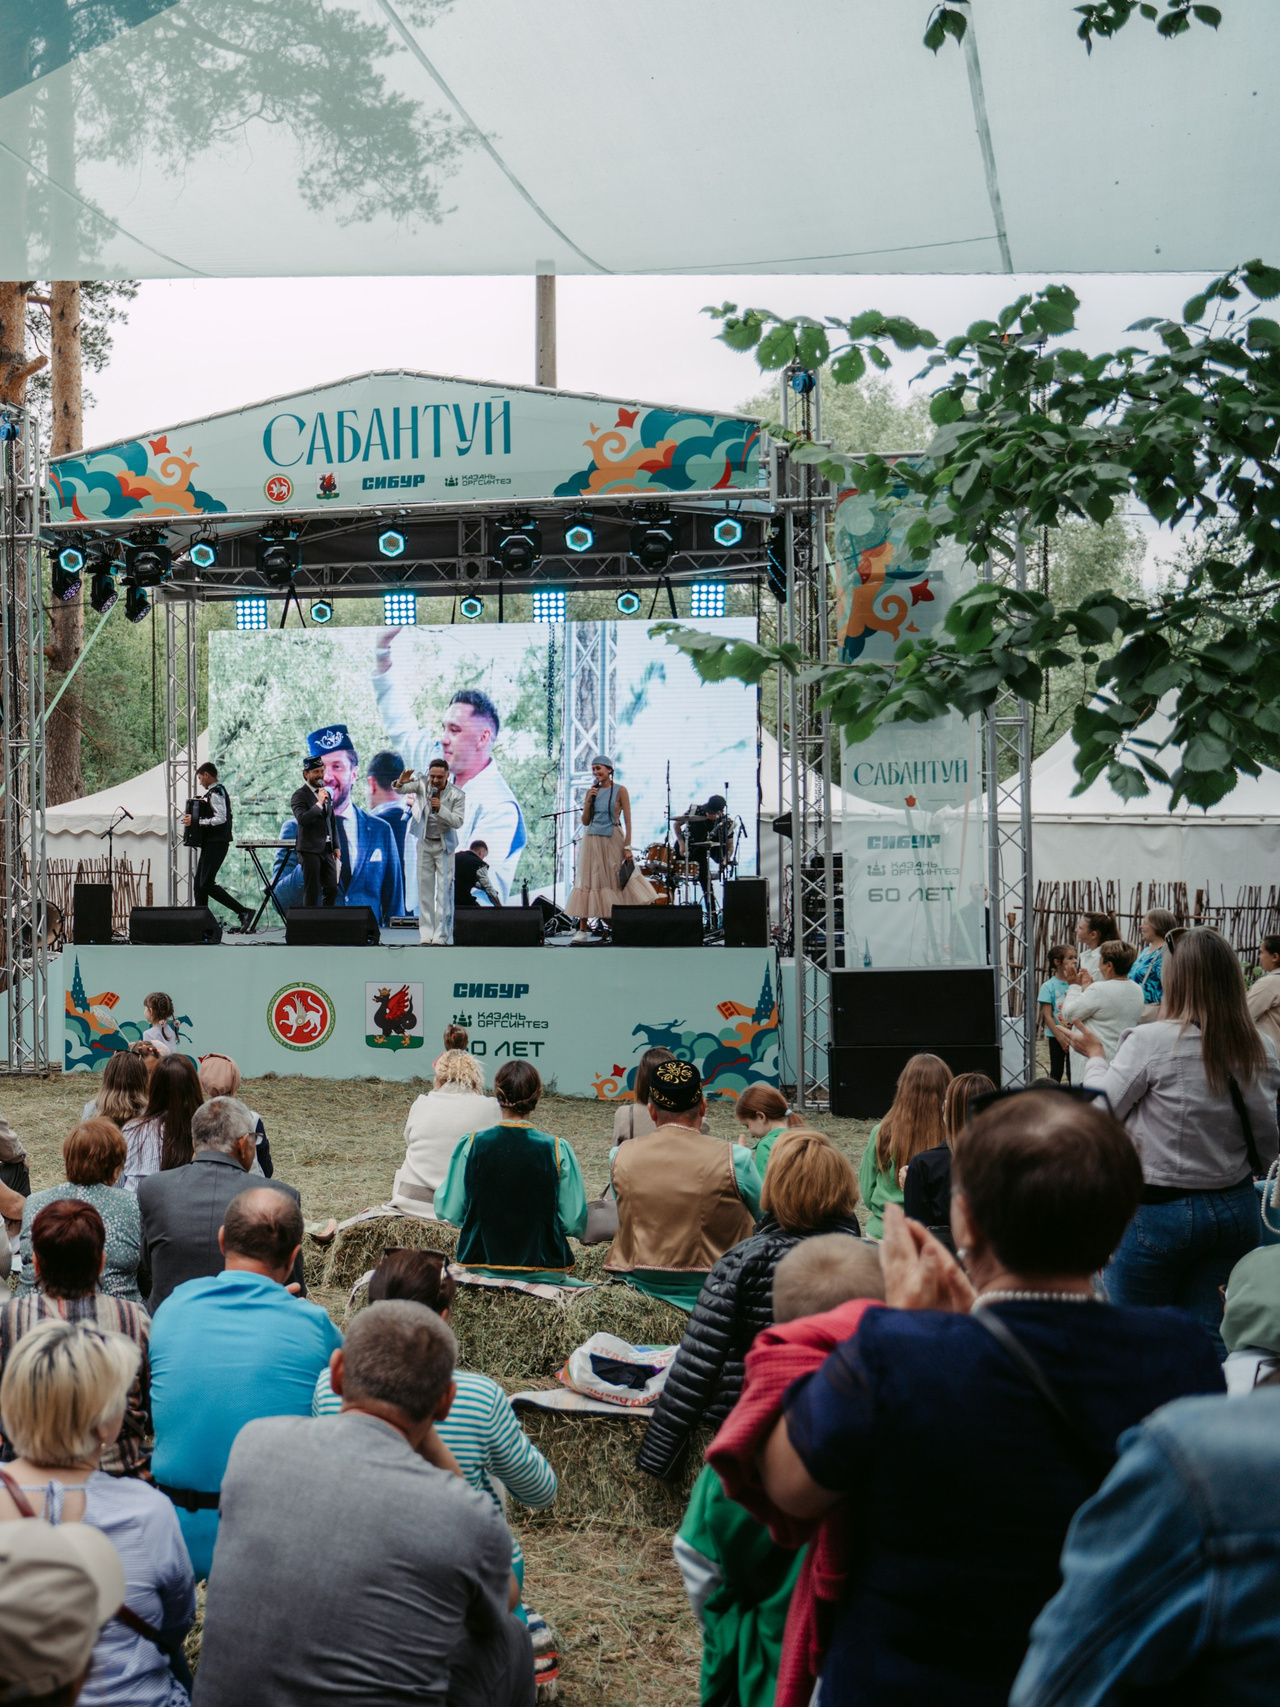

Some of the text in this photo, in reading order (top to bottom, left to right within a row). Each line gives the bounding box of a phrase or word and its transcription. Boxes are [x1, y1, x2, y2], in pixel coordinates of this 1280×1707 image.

[262, 395, 511, 467] САБАНТУЙ
[362, 474, 425, 490] СИБУР
[462, 478, 512, 487] ОРГСИНТЕЗ
[853, 757, 968, 786] САБАНТУЙ
[867, 834, 940, 849] СИБУР
[891, 861, 938, 869] КАЗАНЬ
[891, 867, 960, 876] ОРГСИНТЕЗ
[868, 887, 956, 902] 60 ЛЕТ
[453, 983, 530, 999] СИБУР
[477, 1012, 526, 1021] КАЗАНЬ
[477, 1020, 549, 1029] ОРГСИНТЕЗ
[494, 1040, 545, 1057] ЛЕТ
